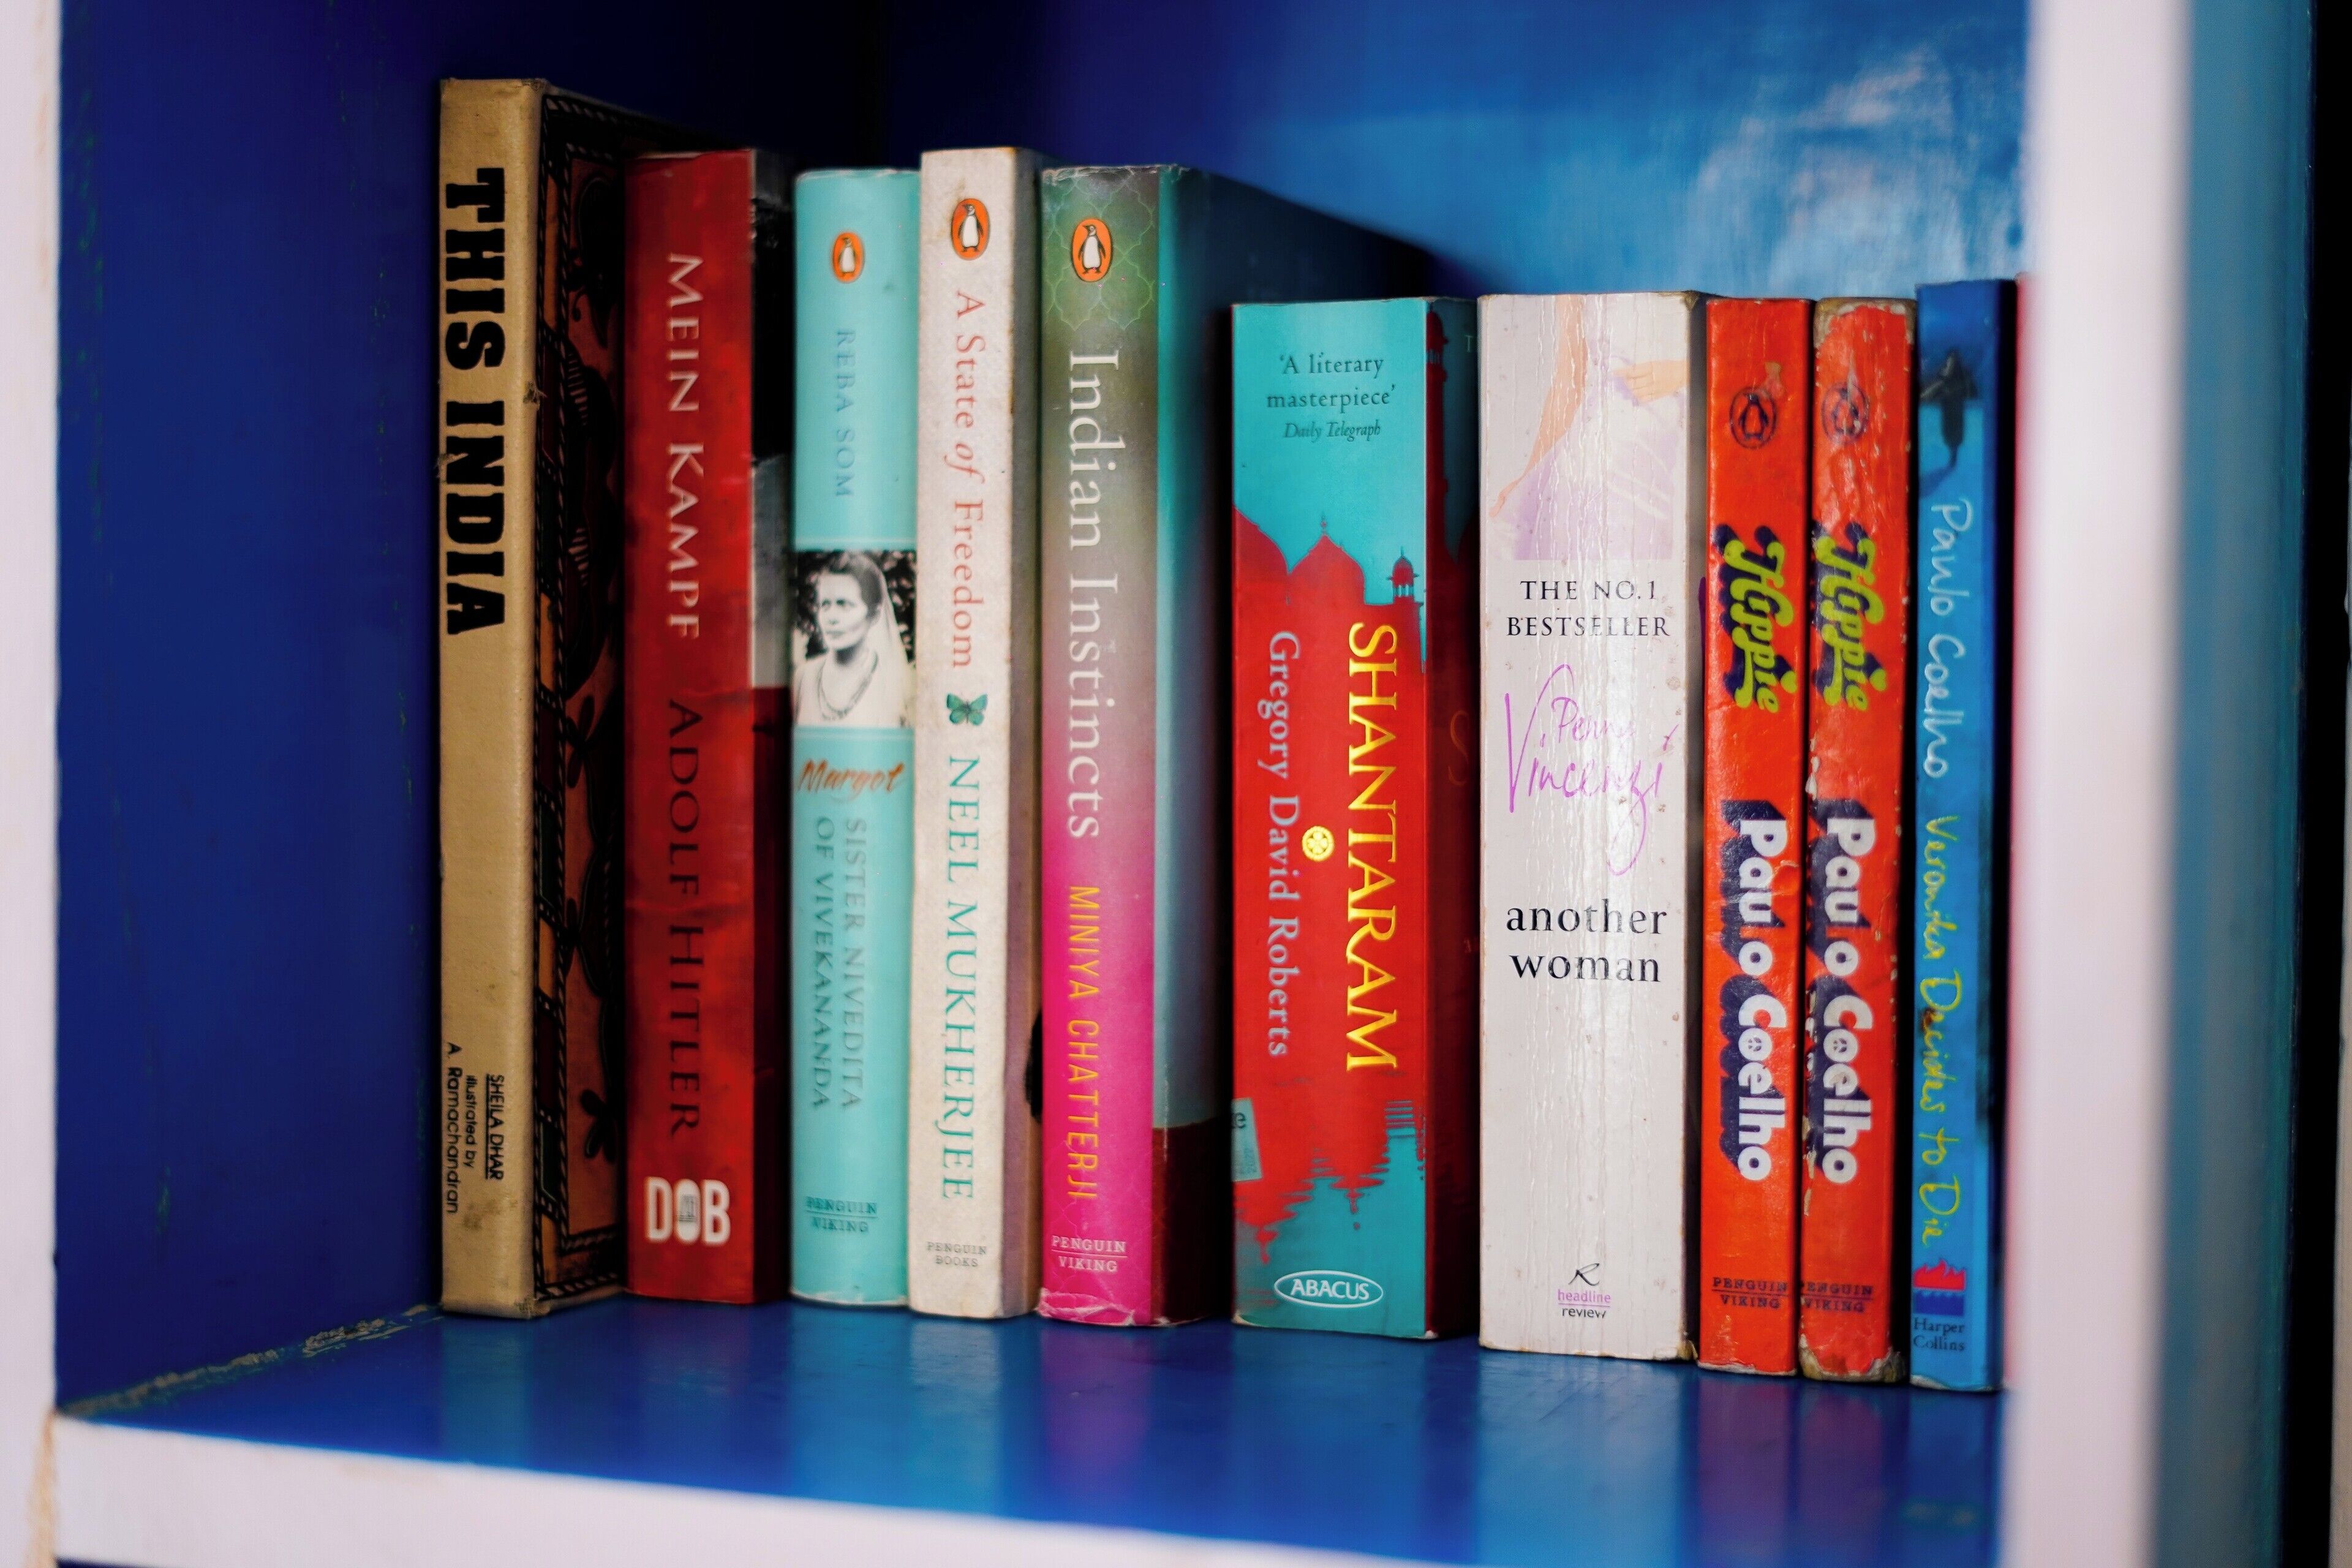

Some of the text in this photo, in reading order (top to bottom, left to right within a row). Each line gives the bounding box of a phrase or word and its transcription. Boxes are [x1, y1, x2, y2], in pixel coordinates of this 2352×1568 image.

[1309, 352, 1384, 379] literary
[445, 167, 505, 635] THIS INDIA
[835, 329, 856, 498] REBA SOM
[1282, 421, 1381, 441] Daily Telegraph
[668, 254, 704, 639] MEIN KAMPF
[944, 290, 986, 669] A State of Freedom
[1069, 350, 1125, 838] Indian Instincts
[1520, 580, 1656, 601] THE NO.1
[1815, 536, 1887, 711] Hippie
[1506, 617, 1670, 638] BESTSELLER
[1724, 540, 1797, 713] Hippie
[1924, 499, 1973, 777] Paulo Coelho
[794, 759, 905, 798] Margot
[1257, 631, 1300, 1057] Gregory David Roberts
[1346, 622, 1397, 1071] SHANTARAM
[669, 699, 704, 1136] ADOLF HITLER
[1506, 898, 1667, 937] another
[812, 815, 836, 1110] OF VIVEKANANDA
[842, 817, 866, 1110] SISTER NIVEDITA
[935, 755, 979, 1200] NEEL MUKHERJEE
[1510, 951, 1660, 983] woman
[1068, 886, 1099, 1199] MINIYA CHATTERJI
[1917, 815, 1961, 1247] Veronika Decides to Die
[1738, 993, 1787, 1180] Coelho
[1822, 993, 1874, 1183] Coelho
[447, 1067, 463, 1214] Ramachandran
[462, 1075, 478, 1168] illustrated by
[489, 1074, 505, 1180] SHEILA DHAR
[646, 1176, 731, 1245] DOB
[805, 1196, 877, 1215] PENGUIN
[811, 1218, 870, 1233] VIKING
[926, 1241, 987, 1256] PENGUIN
[935, 1254, 979, 1268] BOOKS
[1051, 1235, 1126, 1254] PENGUIN
[1058, 1256, 1118, 1273] VIKING
[1290, 1278, 1369, 1301] ABACUS
[1557, 1288, 1611, 1305] headline
[1560, 1306, 1607, 1319] review
[1713, 1276, 1788, 1292] PENGUIN
[1721, 1294, 1781, 1309] VIKING
[1804, 1297, 1864, 1313] VIKING
[1913, 1317, 1964, 1333] Harper
[1913, 1335, 1965, 1352] Collins
